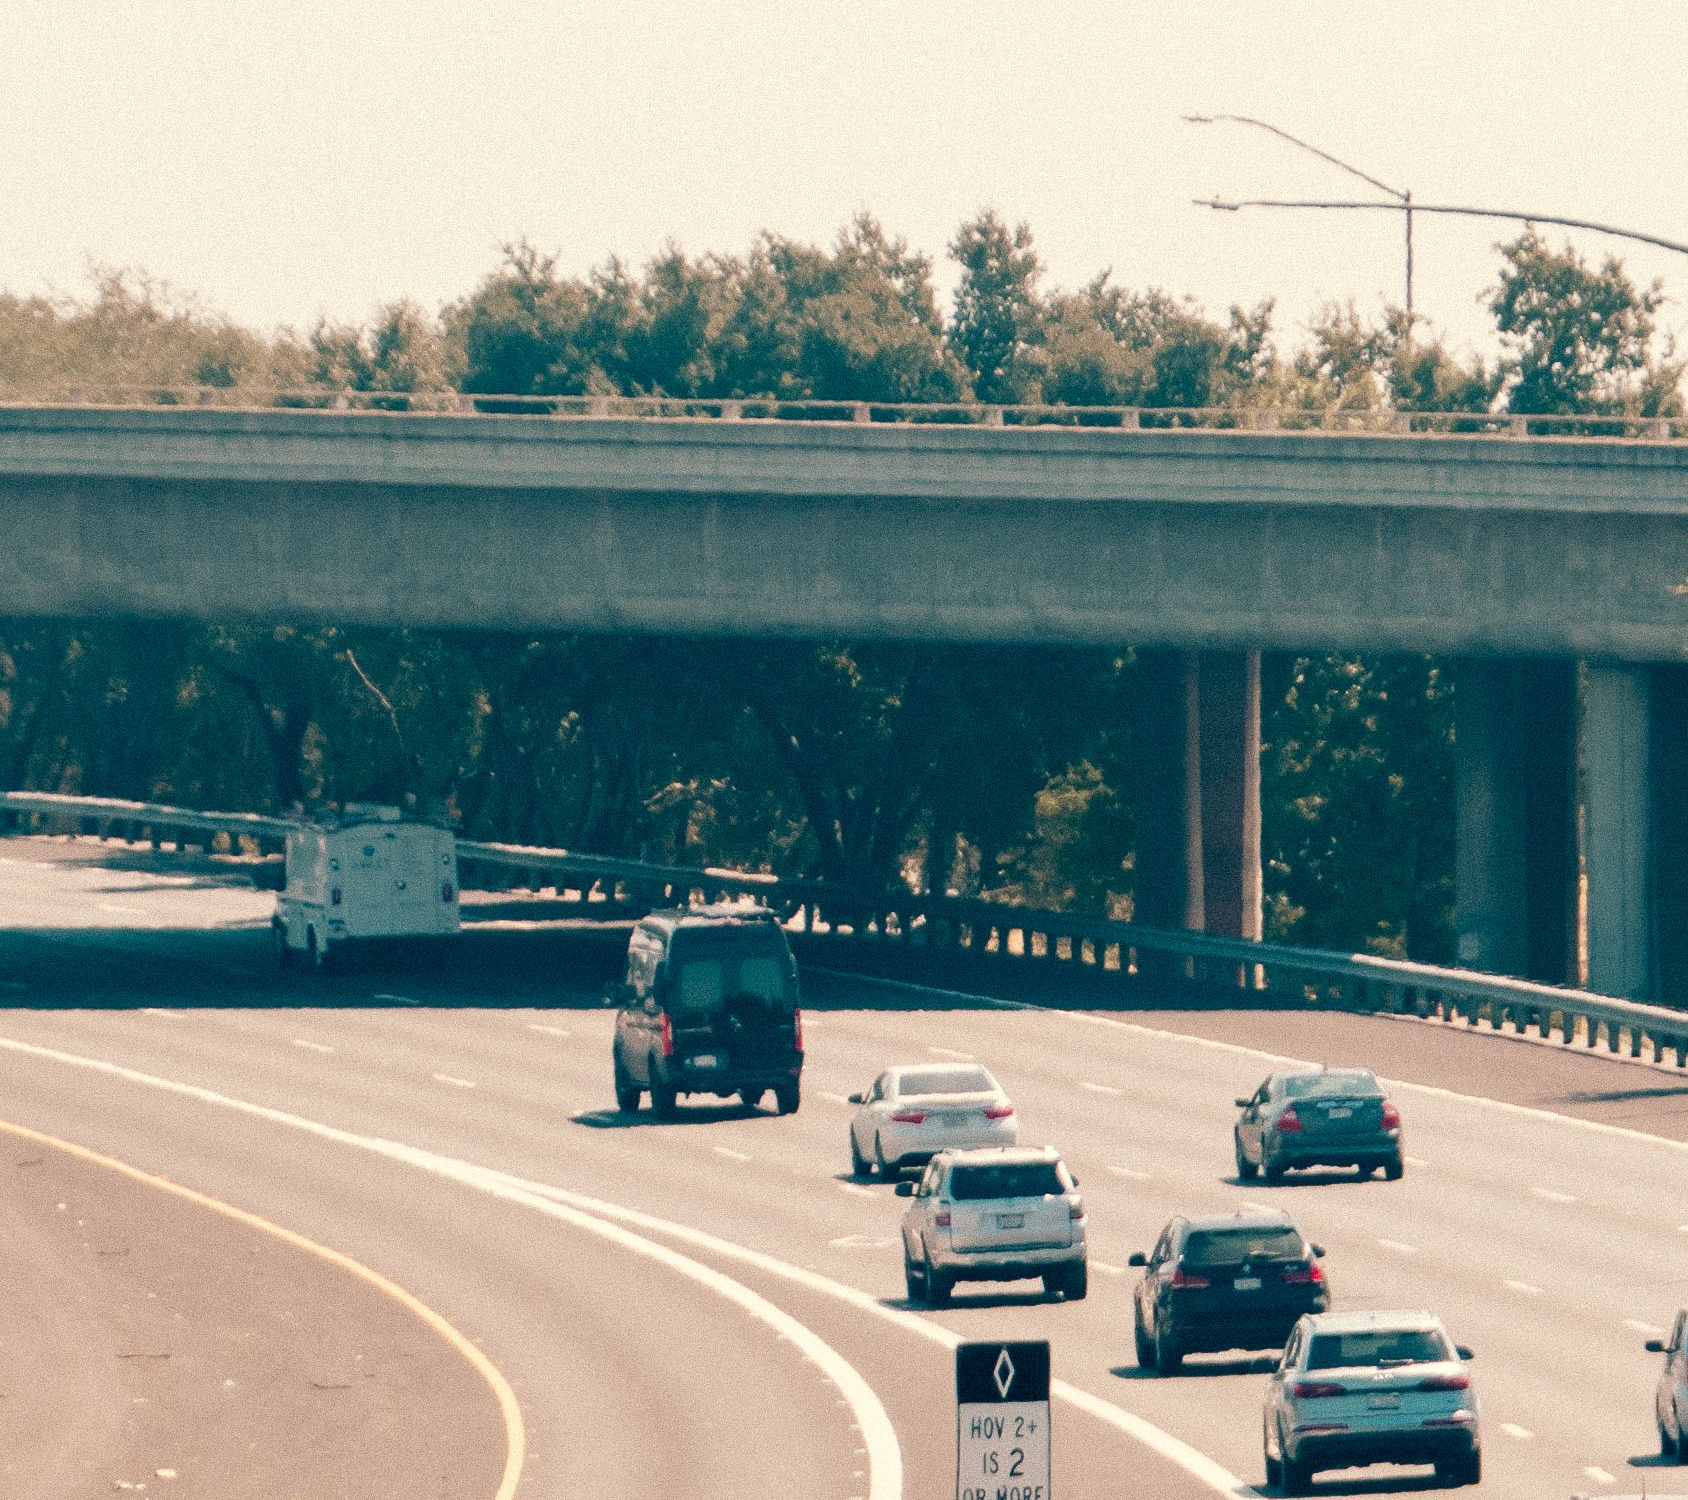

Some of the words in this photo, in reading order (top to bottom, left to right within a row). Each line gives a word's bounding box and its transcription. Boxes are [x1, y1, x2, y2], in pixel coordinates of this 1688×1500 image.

[971, 1416, 1005, 1439] HOV
[1014, 1416, 1038, 1438] 2+
[983, 1452, 999, 1474] IS
[1009, 1447, 1025, 1477] 2
